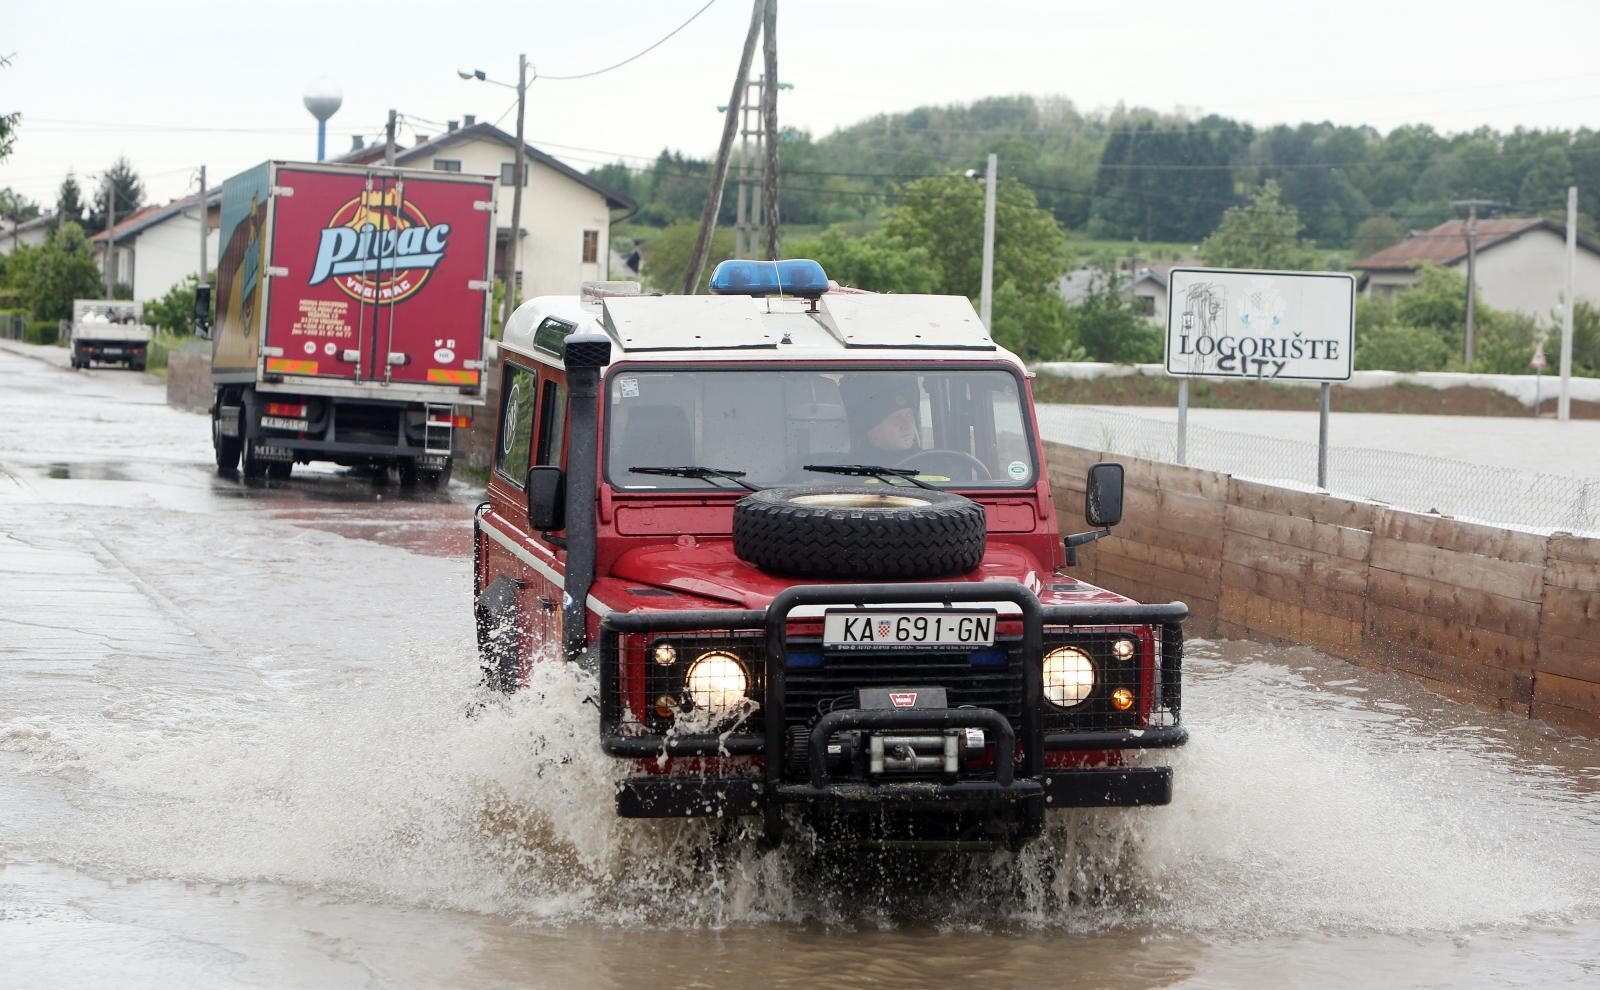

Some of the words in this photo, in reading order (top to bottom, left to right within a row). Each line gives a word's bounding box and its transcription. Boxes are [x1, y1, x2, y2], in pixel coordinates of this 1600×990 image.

[309, 223, 450, 285] Pivac
[346, 276, 411, 298] VRGORAC
[1179, 331, 1339, 360] LOGORIŠTE
[1217, 355, 1286, 380] CITY
[843, 617, 874, 642] KA
[895, 616, 991, 642] 691-GN
